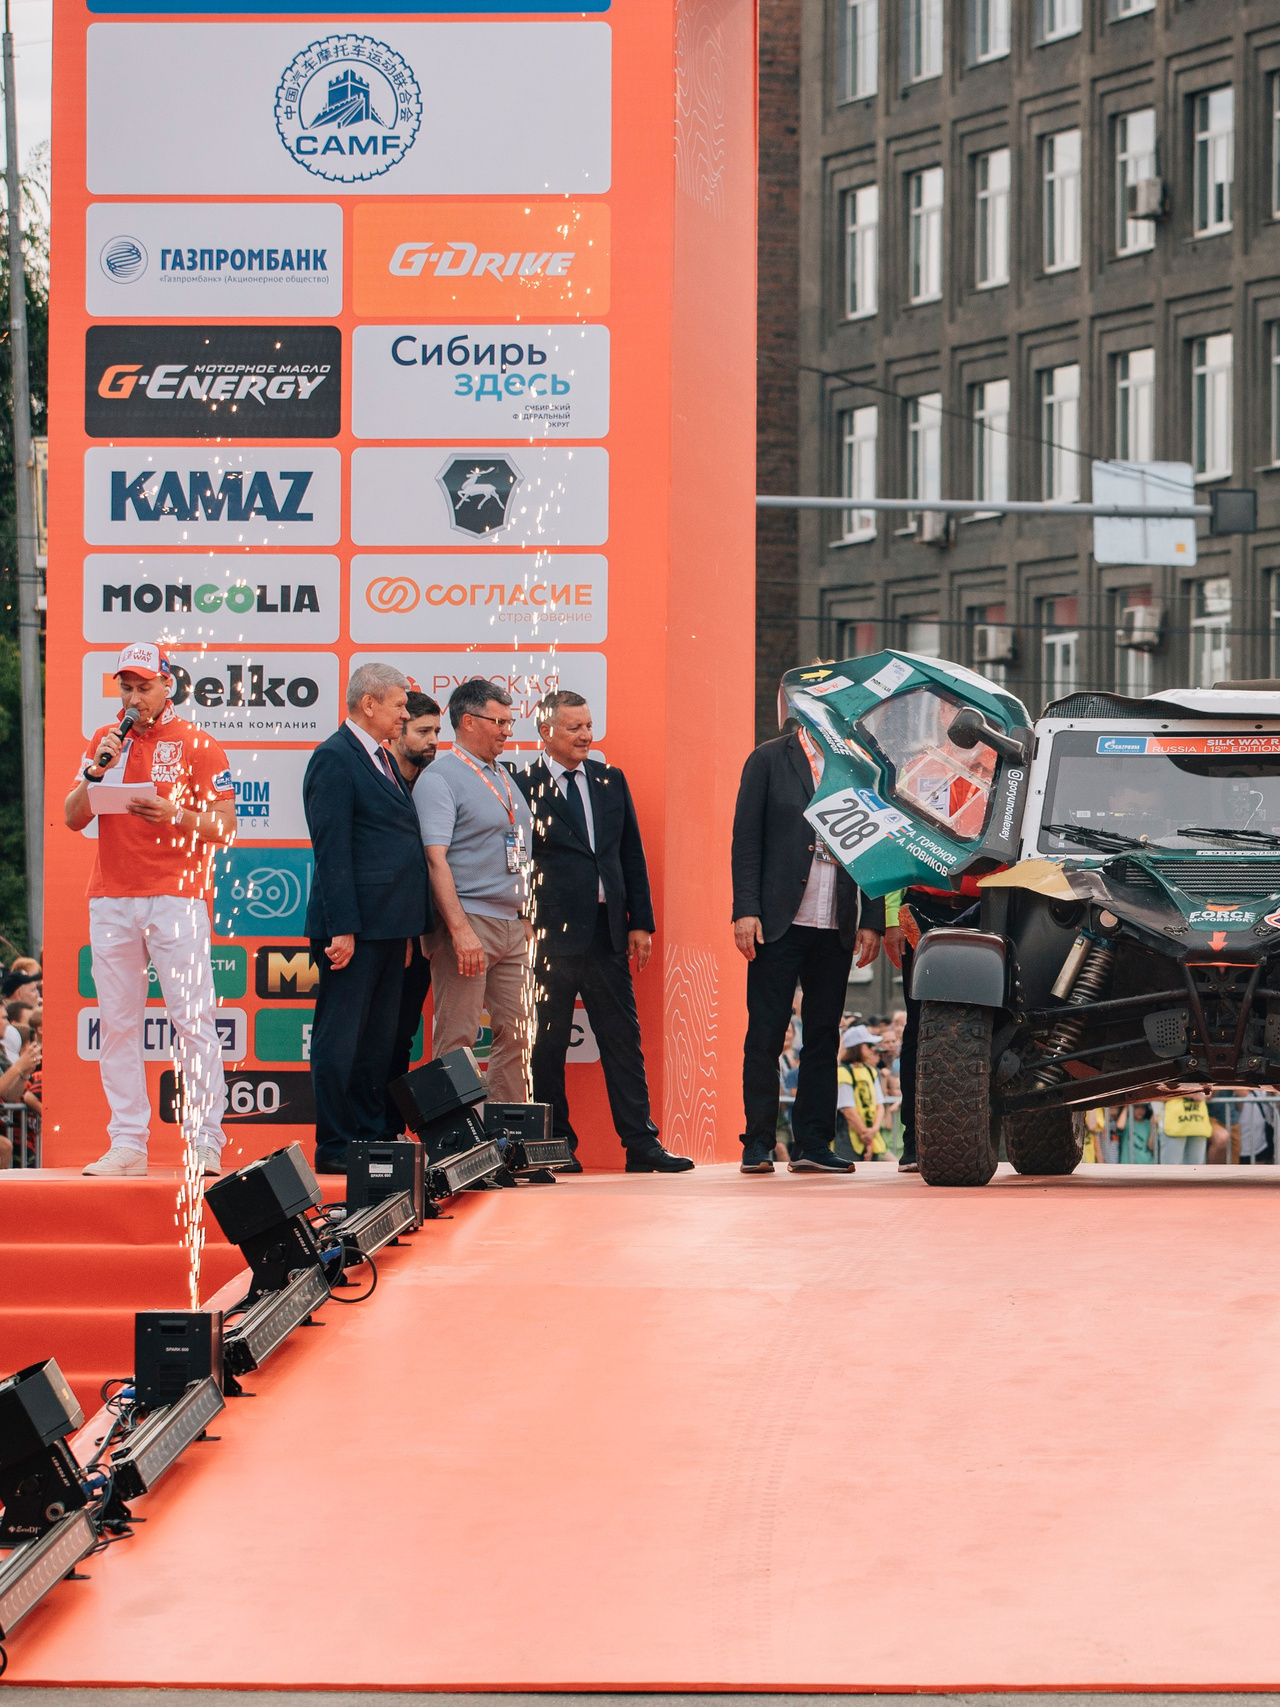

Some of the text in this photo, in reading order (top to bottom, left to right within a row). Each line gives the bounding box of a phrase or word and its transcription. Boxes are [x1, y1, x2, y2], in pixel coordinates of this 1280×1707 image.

[283, 44, 414, 123] 中国汽车摩托车运动联合会
[295, 135, 401, 156] CAMF
[160, 248, 328, 271] ГАЗПРОМБАНК
[391, 334, 548, 374] Сибирь
[193, 364, 331, 374] МОТОРНОЕ МАСЛО
[454, 373, 571, 402] здесь
[512, 411, 571, 420] ФДЕРАЛЬНЫЙ
[110, 471, 314, 521] KAMAZ
[102, 583, 320, 614] MONGOLIA
[425, 584, 592, 606] СОГЛАСИЕ
[498, 612, 593, 623] страование
[433, 675, 559, 694] РУСКАЯ
[249, 721, 317, 729] КОМПАНИЯ
[1238, 738, 1268, 746] WAY
[151, 765, 179, 775] SILK
[151, 774, 178, 783] WAY
[815, 798, 880, 850] 208
[905, 842, 949, 877] НОВИКОВ
[1190, 911, 1257, 919] FORCE
